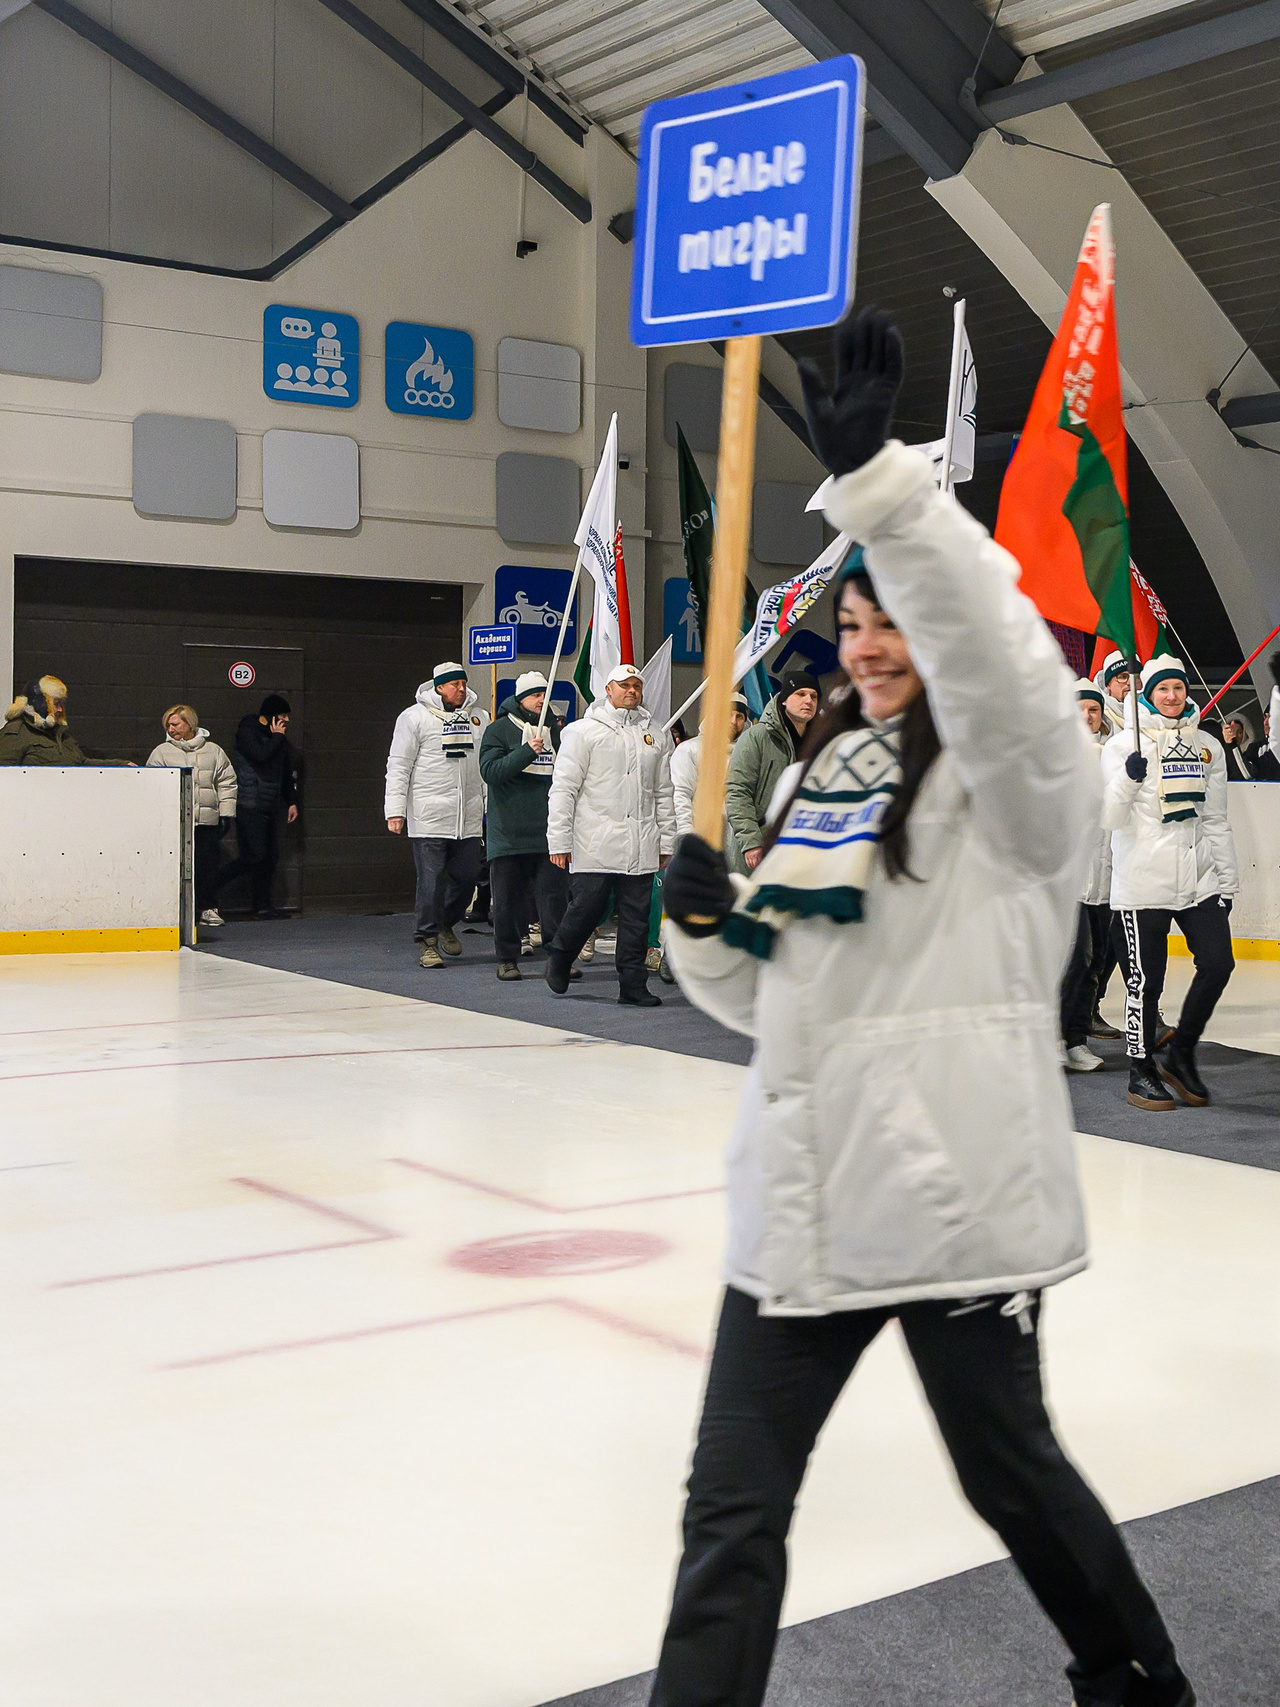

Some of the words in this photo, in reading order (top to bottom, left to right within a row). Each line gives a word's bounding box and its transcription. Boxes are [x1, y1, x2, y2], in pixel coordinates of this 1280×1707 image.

[689, 141, 806, 203] Белые
[678, 213, 808, 281] тигры
[475, 633, 511, 645] Академия
[479, 645, 507, 656] сервиса
